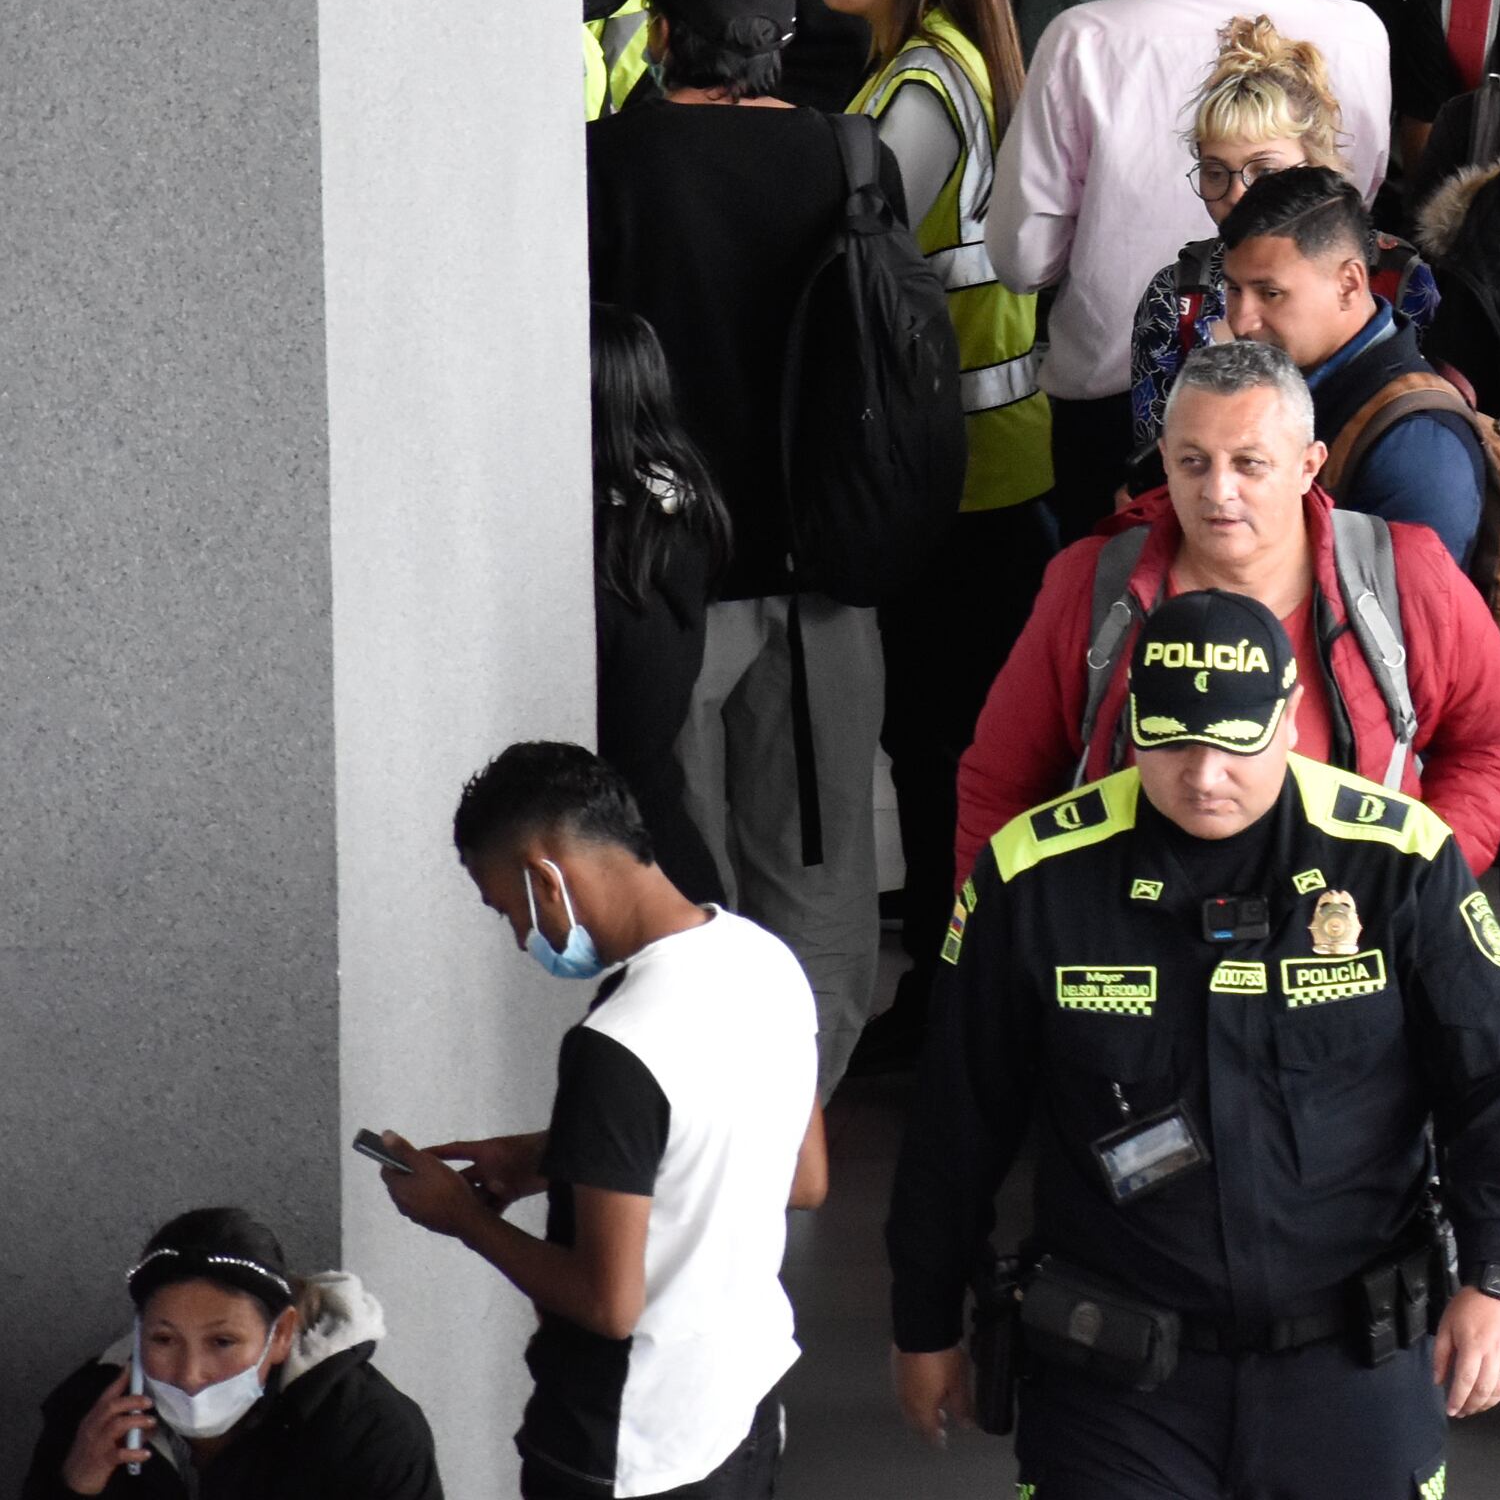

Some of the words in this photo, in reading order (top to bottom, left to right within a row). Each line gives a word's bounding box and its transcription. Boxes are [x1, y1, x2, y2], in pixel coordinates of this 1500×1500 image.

[1144, 638, 1270, 673] POLICÍA
[1086, 972, 1125, 983] Mayor
[1297, 962, 1370, 985] POLICÍA
[1063, 984, 1101, 997] NELSON
